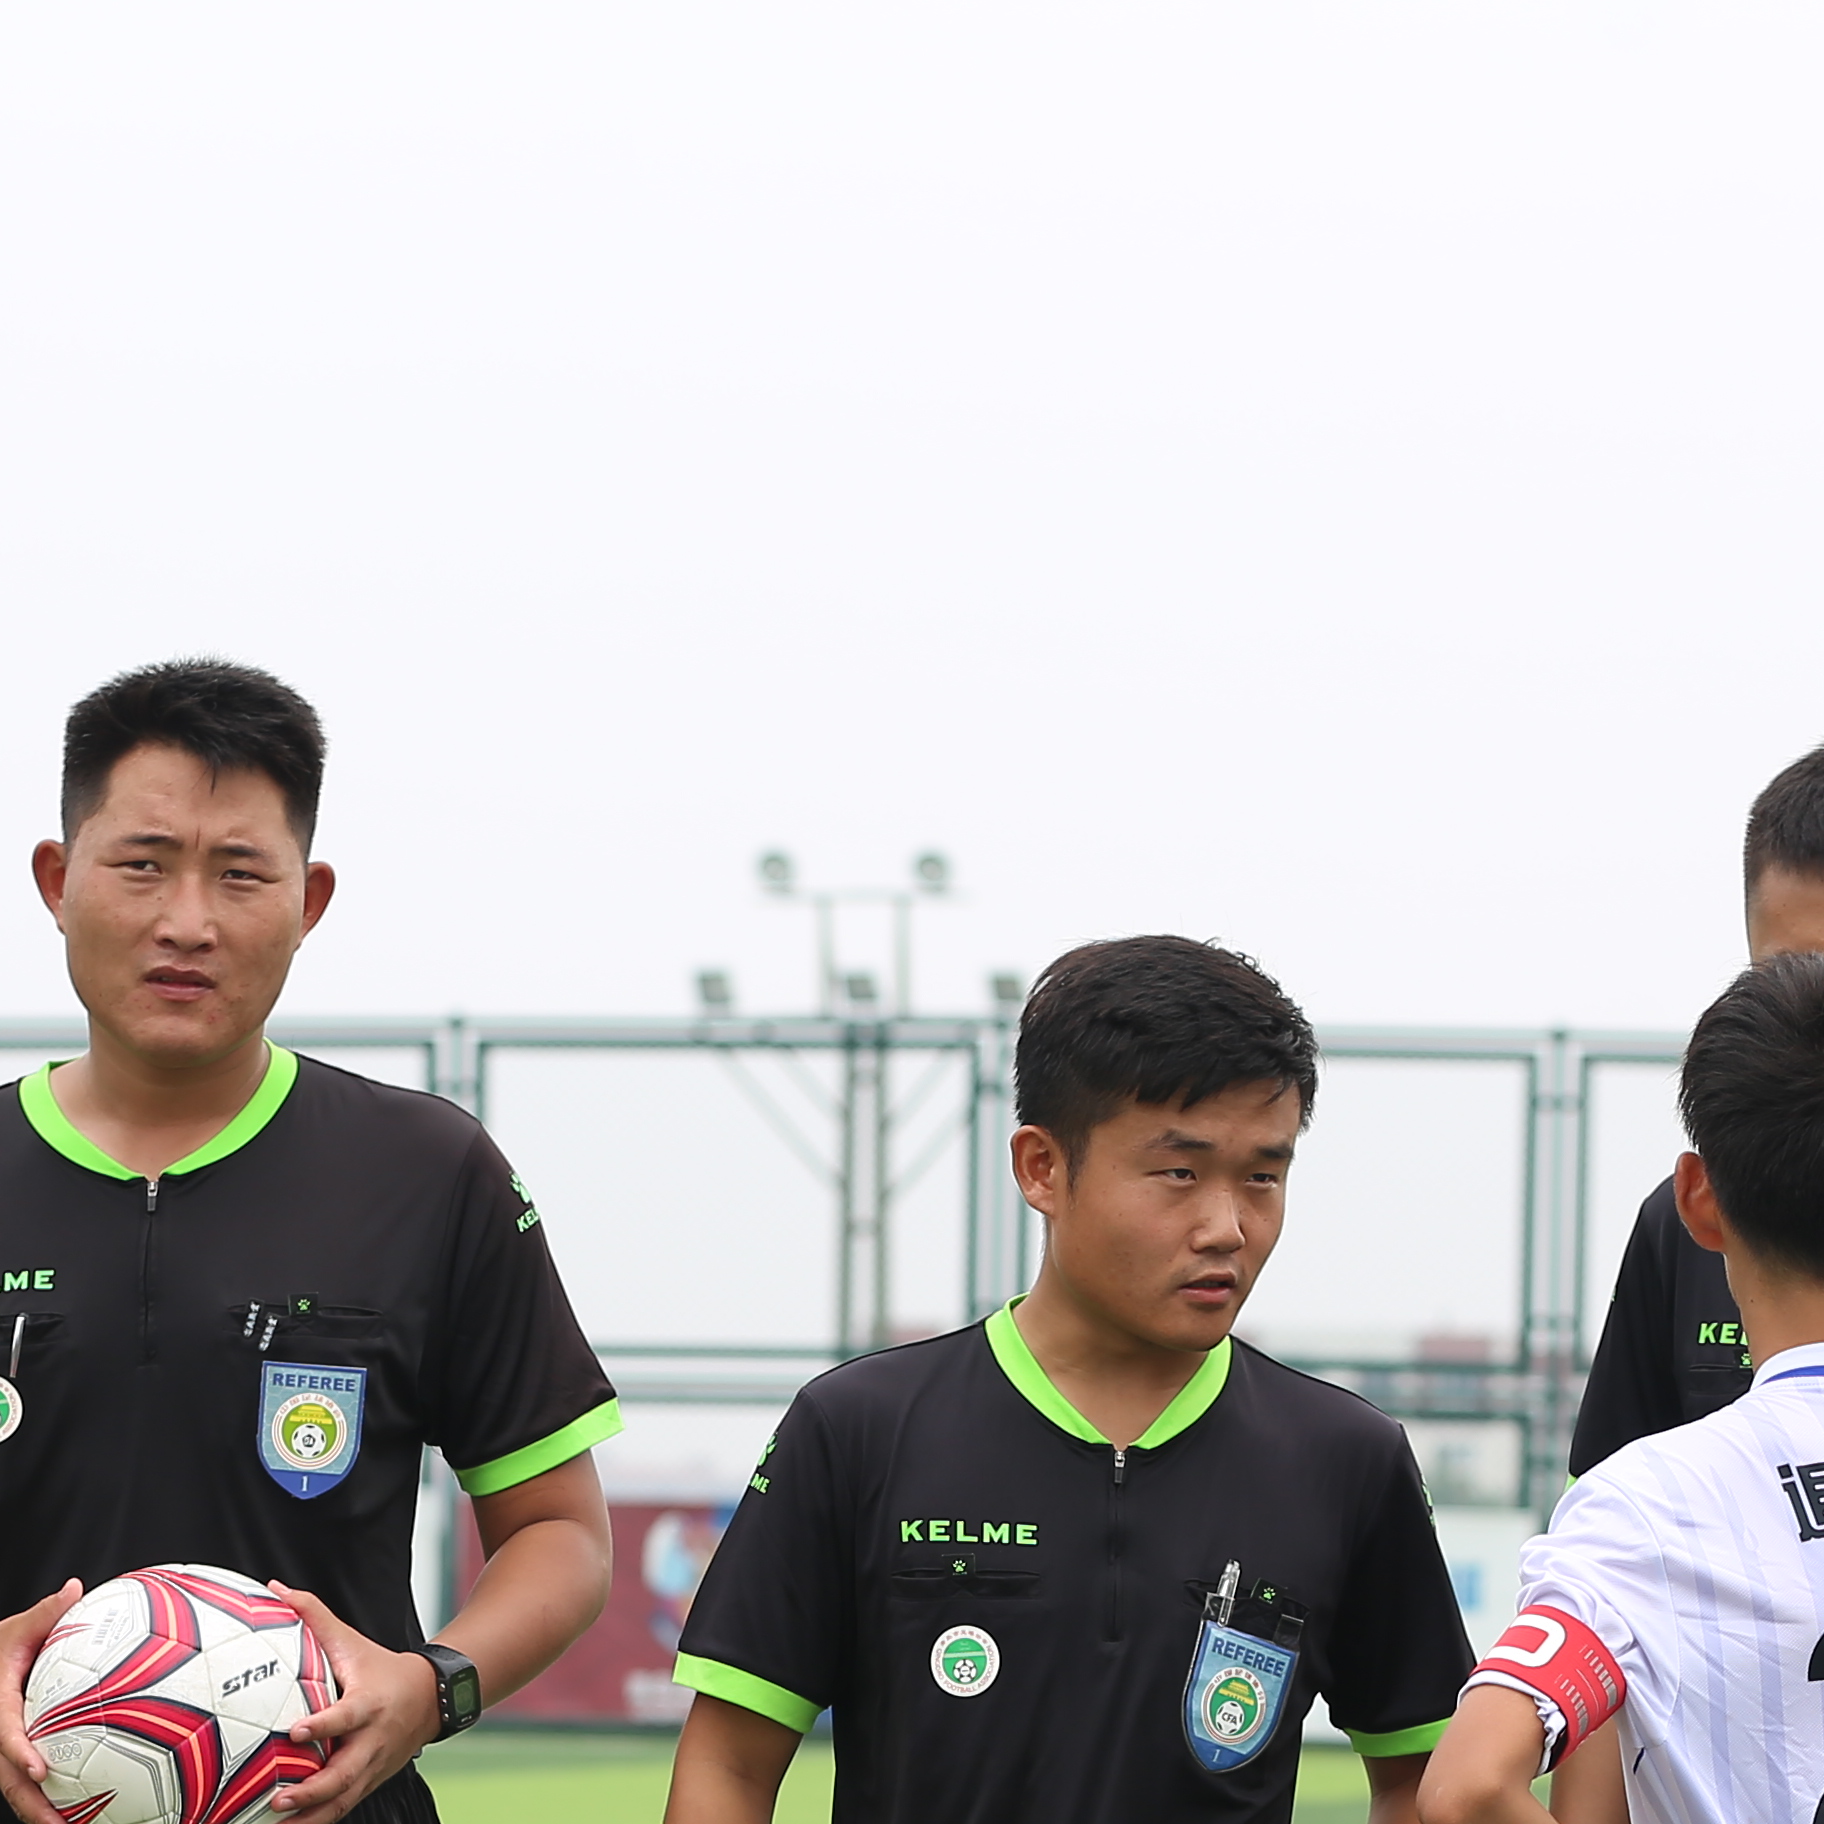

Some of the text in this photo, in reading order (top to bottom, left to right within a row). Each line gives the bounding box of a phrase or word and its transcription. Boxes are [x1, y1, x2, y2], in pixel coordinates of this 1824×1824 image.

[272, 1372, 357, 1393] REFEREE
[300, 1475, 309, 1492] 1
[901, 1520, 1038, 1546] KELME
[1211, 1636, 1287, 1679] REFEREE
[1221, 1711, 1238, 1726] CFA
